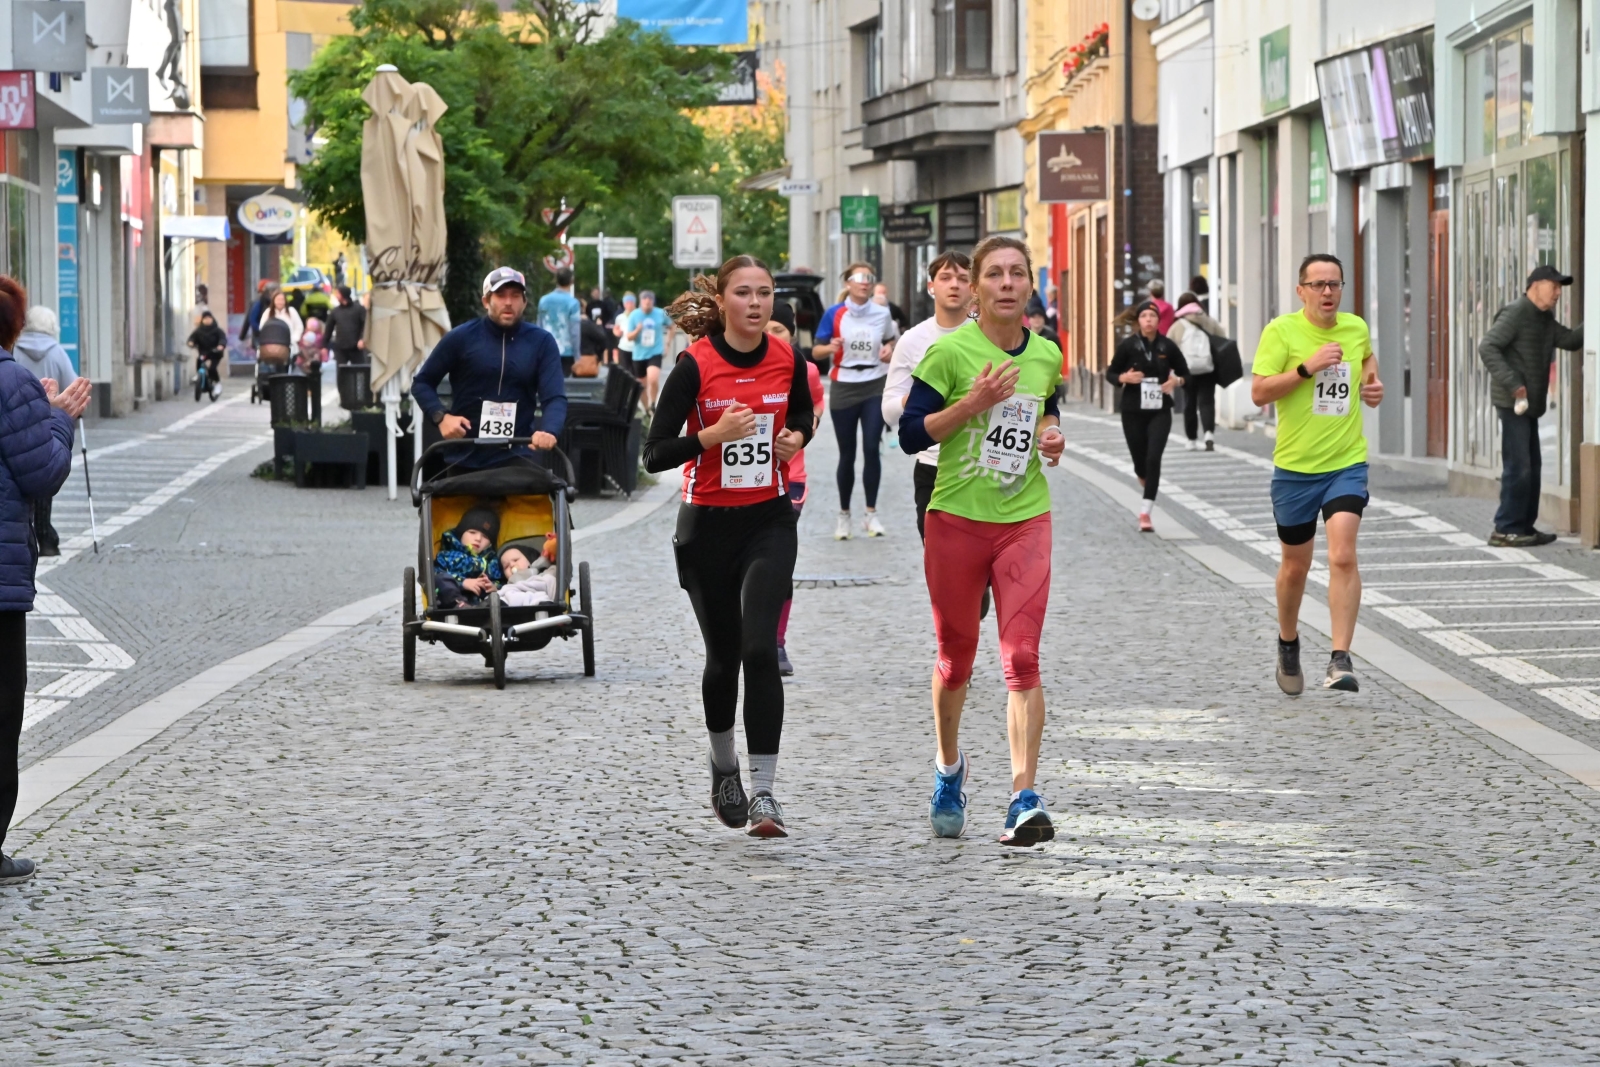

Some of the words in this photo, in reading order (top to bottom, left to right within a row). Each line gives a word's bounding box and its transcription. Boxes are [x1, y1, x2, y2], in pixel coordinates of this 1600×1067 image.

[685, 16, 724, 27] Magnum
[679, 202, 715, 212] POZOR
[850, 340, 872, 352] 685
[1315, 381, 1350, 400] 149
[480, 419, 514, 437] 438
[986, 425, 1032, 453] 463
[723, 442, 771, 467] 635
[986, 458, 1000, 466] CUP
